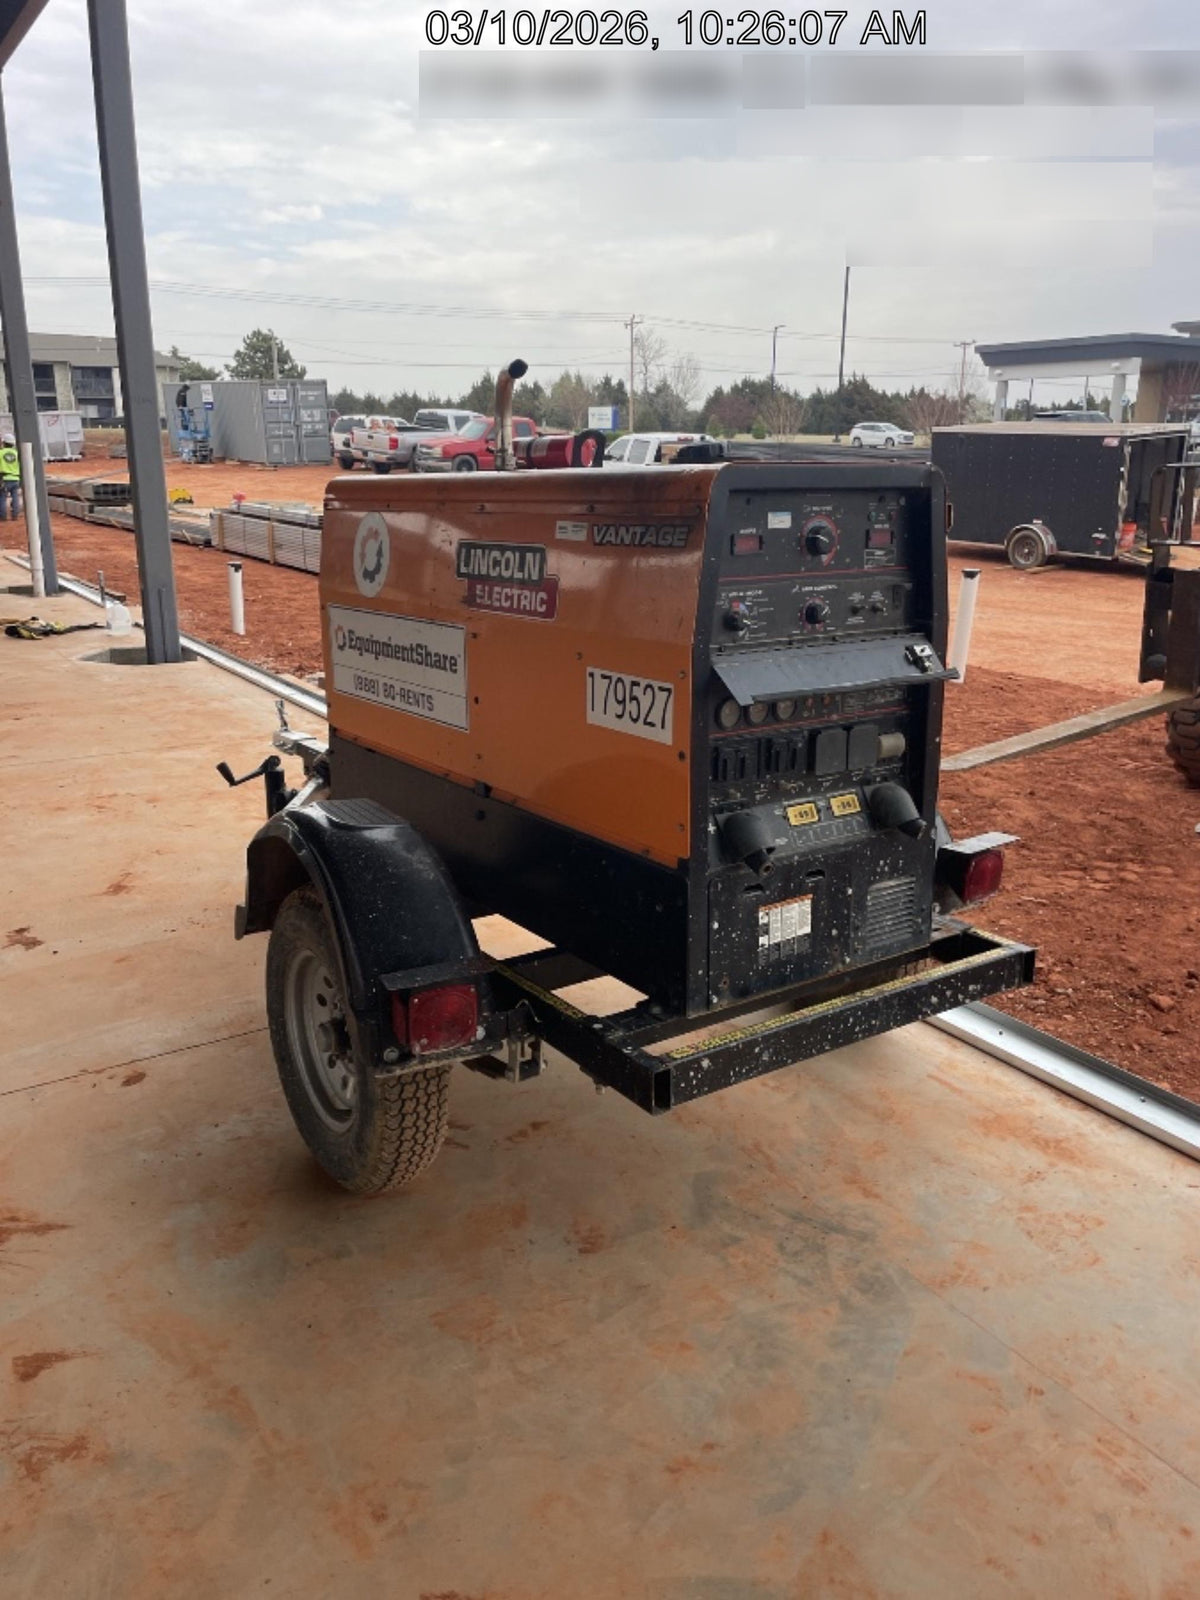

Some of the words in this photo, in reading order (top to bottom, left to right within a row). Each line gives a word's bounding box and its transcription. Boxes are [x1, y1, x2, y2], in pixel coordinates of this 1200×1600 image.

[593, 525, 688, 546] VANTAGE
[460, 547, 541, 580] LINCOLN
[475, 584, 548, 612] ELECTRIC
[347, 629, 458, 674] EquipmentShare
[588, 671, 673, 730] 179527
